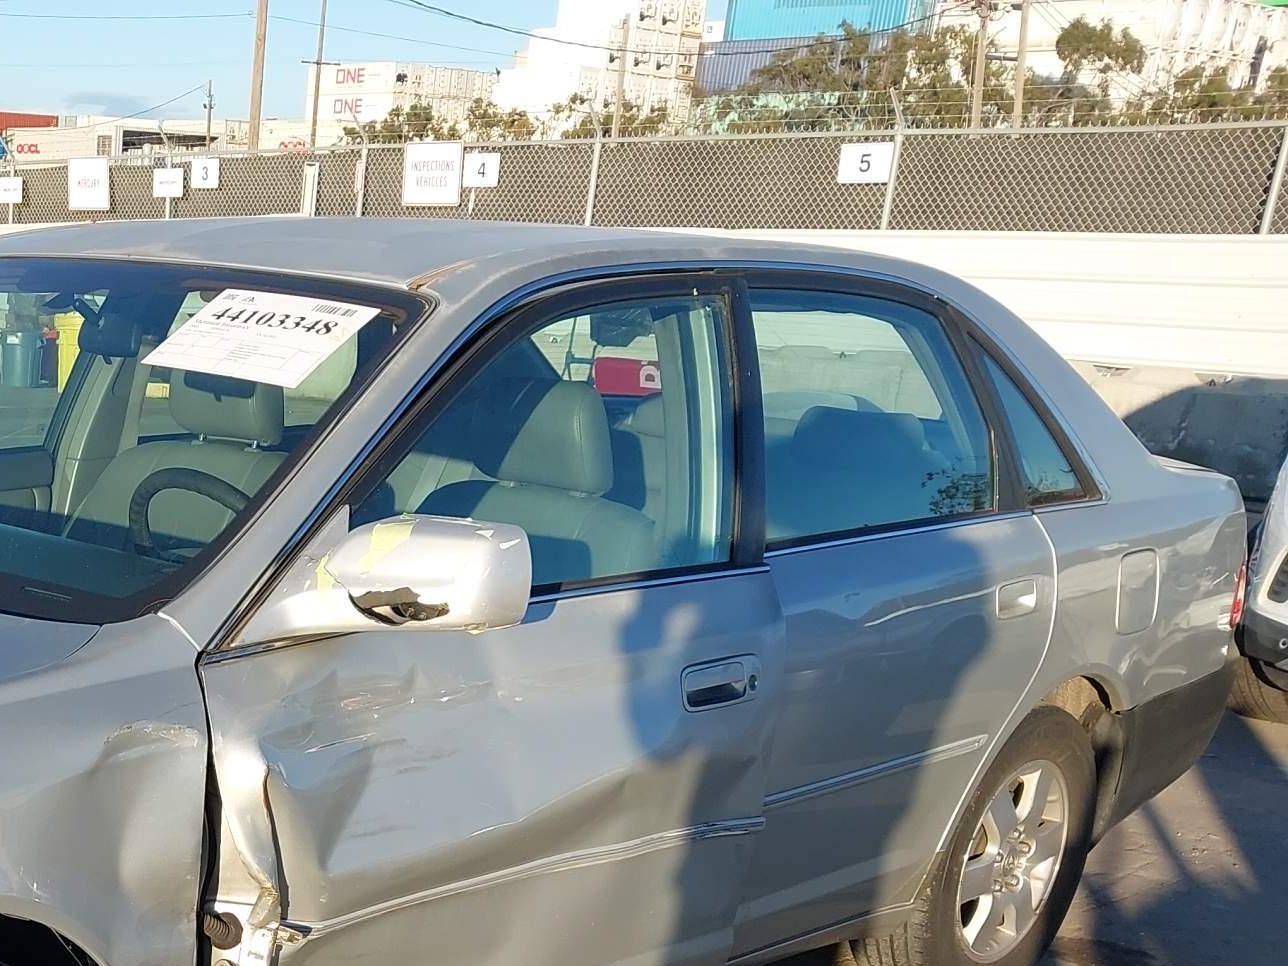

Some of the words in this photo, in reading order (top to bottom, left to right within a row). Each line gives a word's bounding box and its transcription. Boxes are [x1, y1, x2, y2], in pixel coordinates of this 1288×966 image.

[335, 67, 366, 84] ONE
[333, 98, 363, 114] ONE
[16, 144, 41, 154] OOCL
[410, 160, 455, 172] INSPECTIONS
[477, 162, 486, 178] 4
[859, 153, 872, 173] 5
[201, 166, 209, 181] 3
[415, 175, 448, 188] VEHICLES
[211, 306, 339, 336] 44103348
